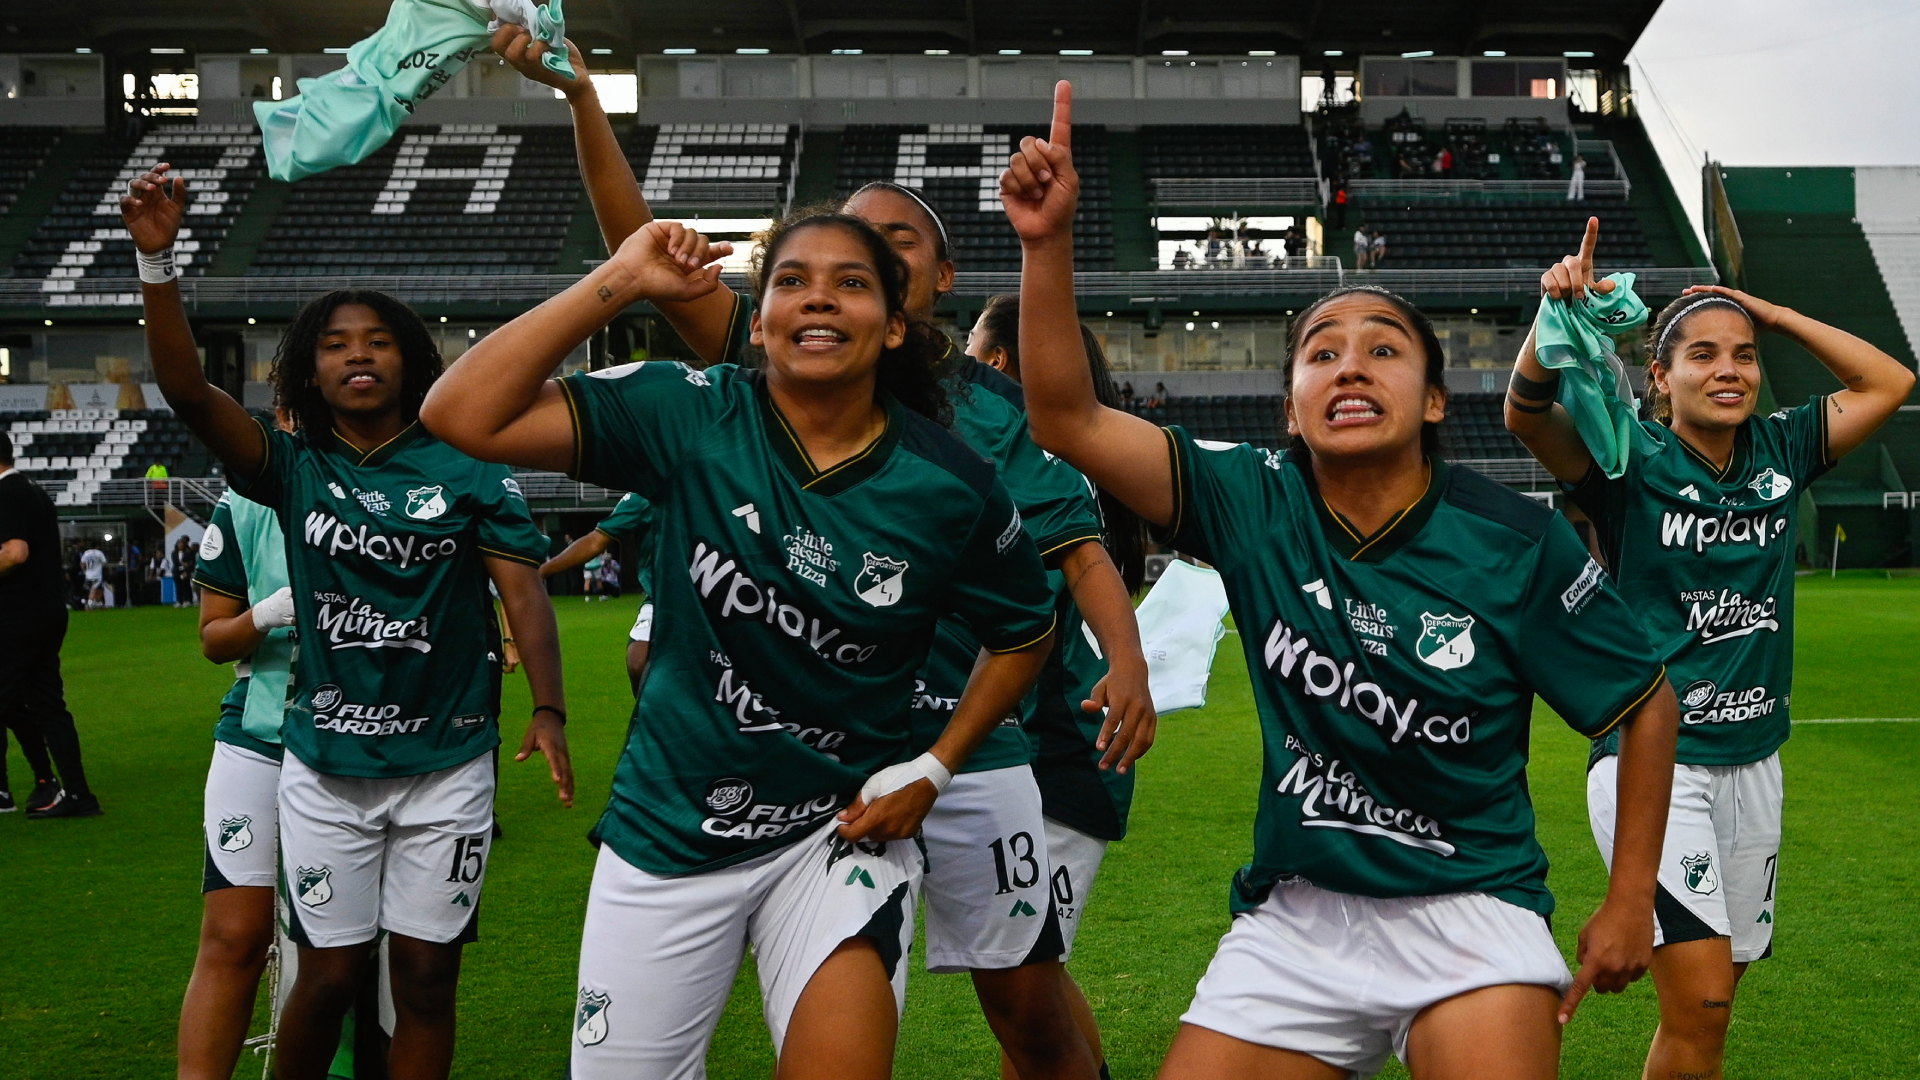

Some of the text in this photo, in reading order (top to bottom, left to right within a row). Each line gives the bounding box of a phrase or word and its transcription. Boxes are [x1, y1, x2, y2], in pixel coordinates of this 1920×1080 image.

[795, 526, 834, 557] Little
[786, 555, 827, 588] Pizza
[867, 559, 903, 572] DEPORTIVO
[866, 566, 893, 603] CALI
[1681, 590, 1715, 601] PASTAS
[1719, 588, 1741, 607] La
[1344, 598, 1387, 624] Little
[1427, 619, 1468, 629] DEPORTIVO
[1426, 626, 1464, 663] CALI
[1713, 686, 1766, 708] FLUO
[313, 715, 430, 735] CARDENT
[337, 704, 401, 720] FLUO
[1683, 698, 1776, 725] CARDENT
[1327, 759, 1356, 789] La
[747, 793, 838, 823] FLUO
[445, 836, 484, 883] 15
[988, 831, 1040, 896] 13
